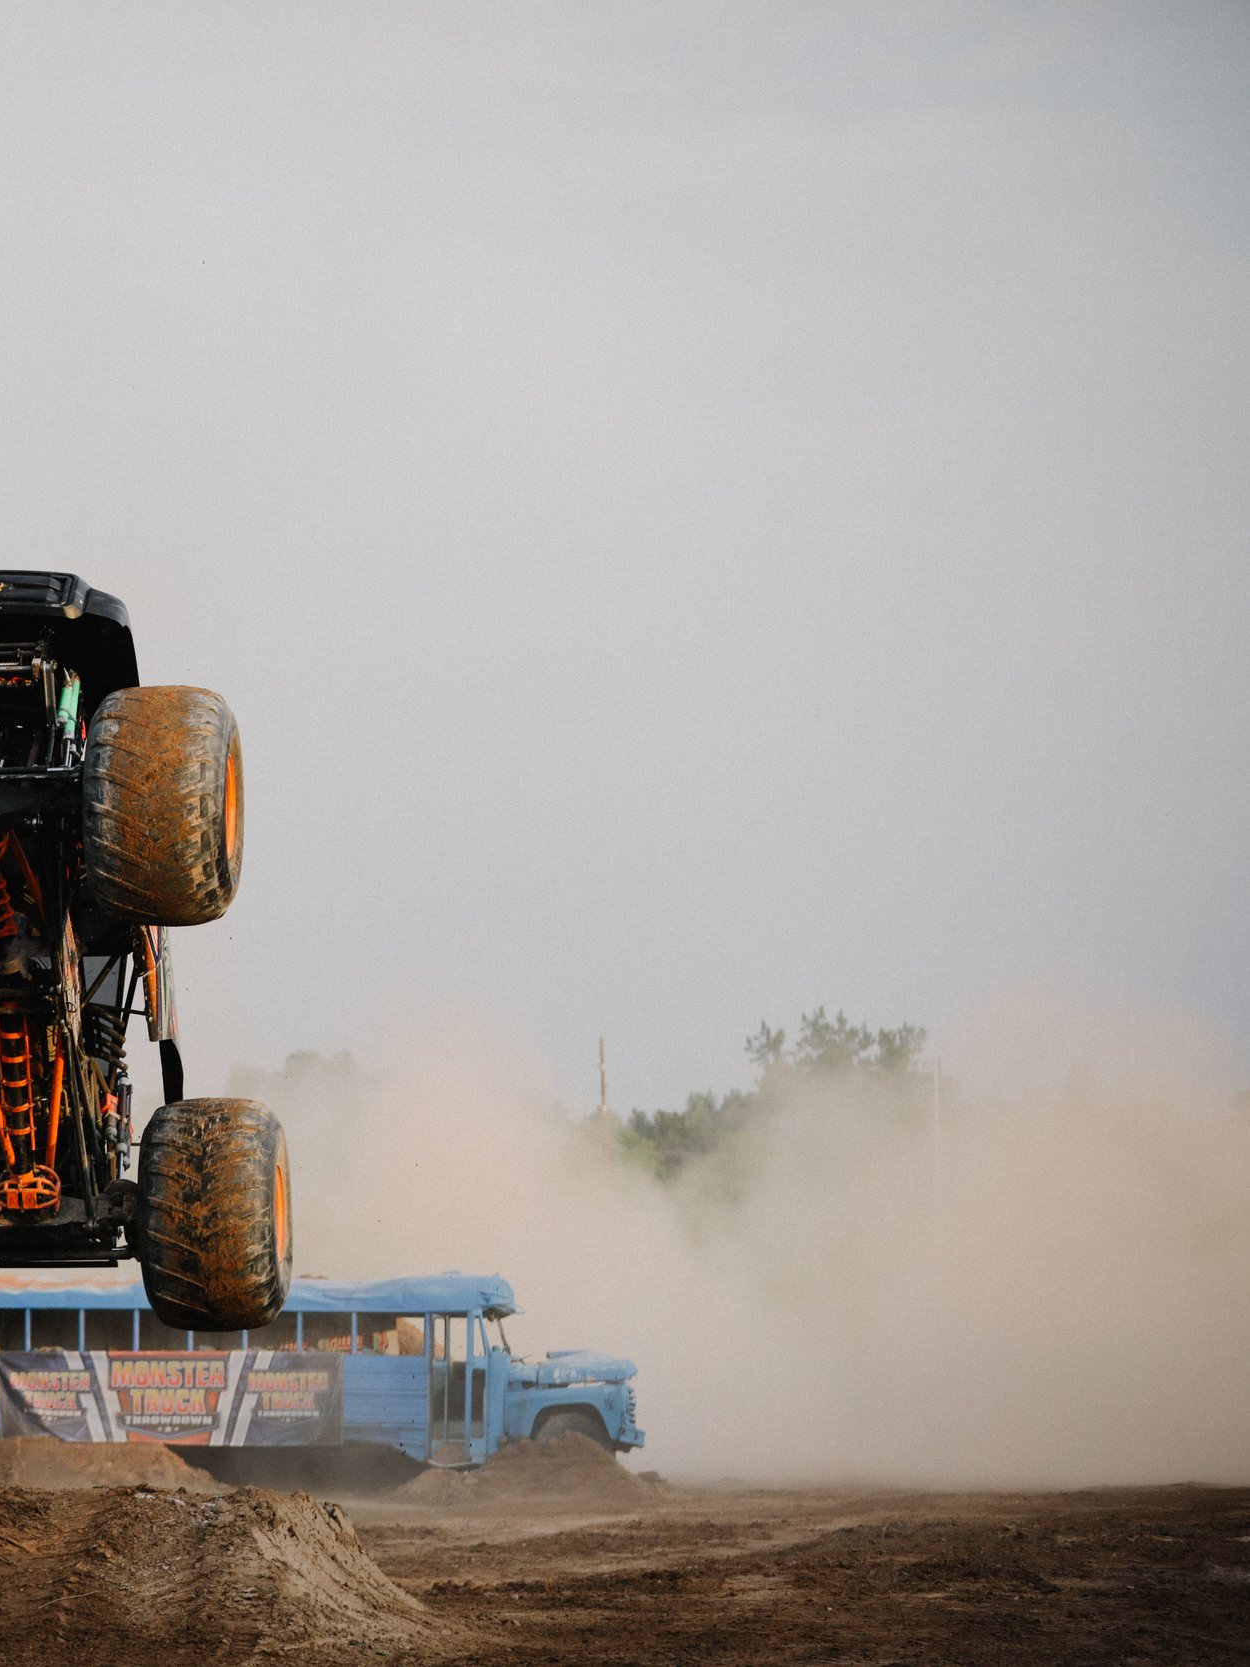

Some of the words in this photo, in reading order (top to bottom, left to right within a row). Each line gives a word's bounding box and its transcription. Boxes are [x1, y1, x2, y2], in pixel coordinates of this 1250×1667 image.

[111, 1360, 225, 1388] MONSTER
[248, 1371, 329, 1391] MONSTER
[130, 1389, 206, 1414] TRUCK
[262, 1391, 316, 1409] TRUCK
[125, 1415, 213, 1425] THROWDOWN
